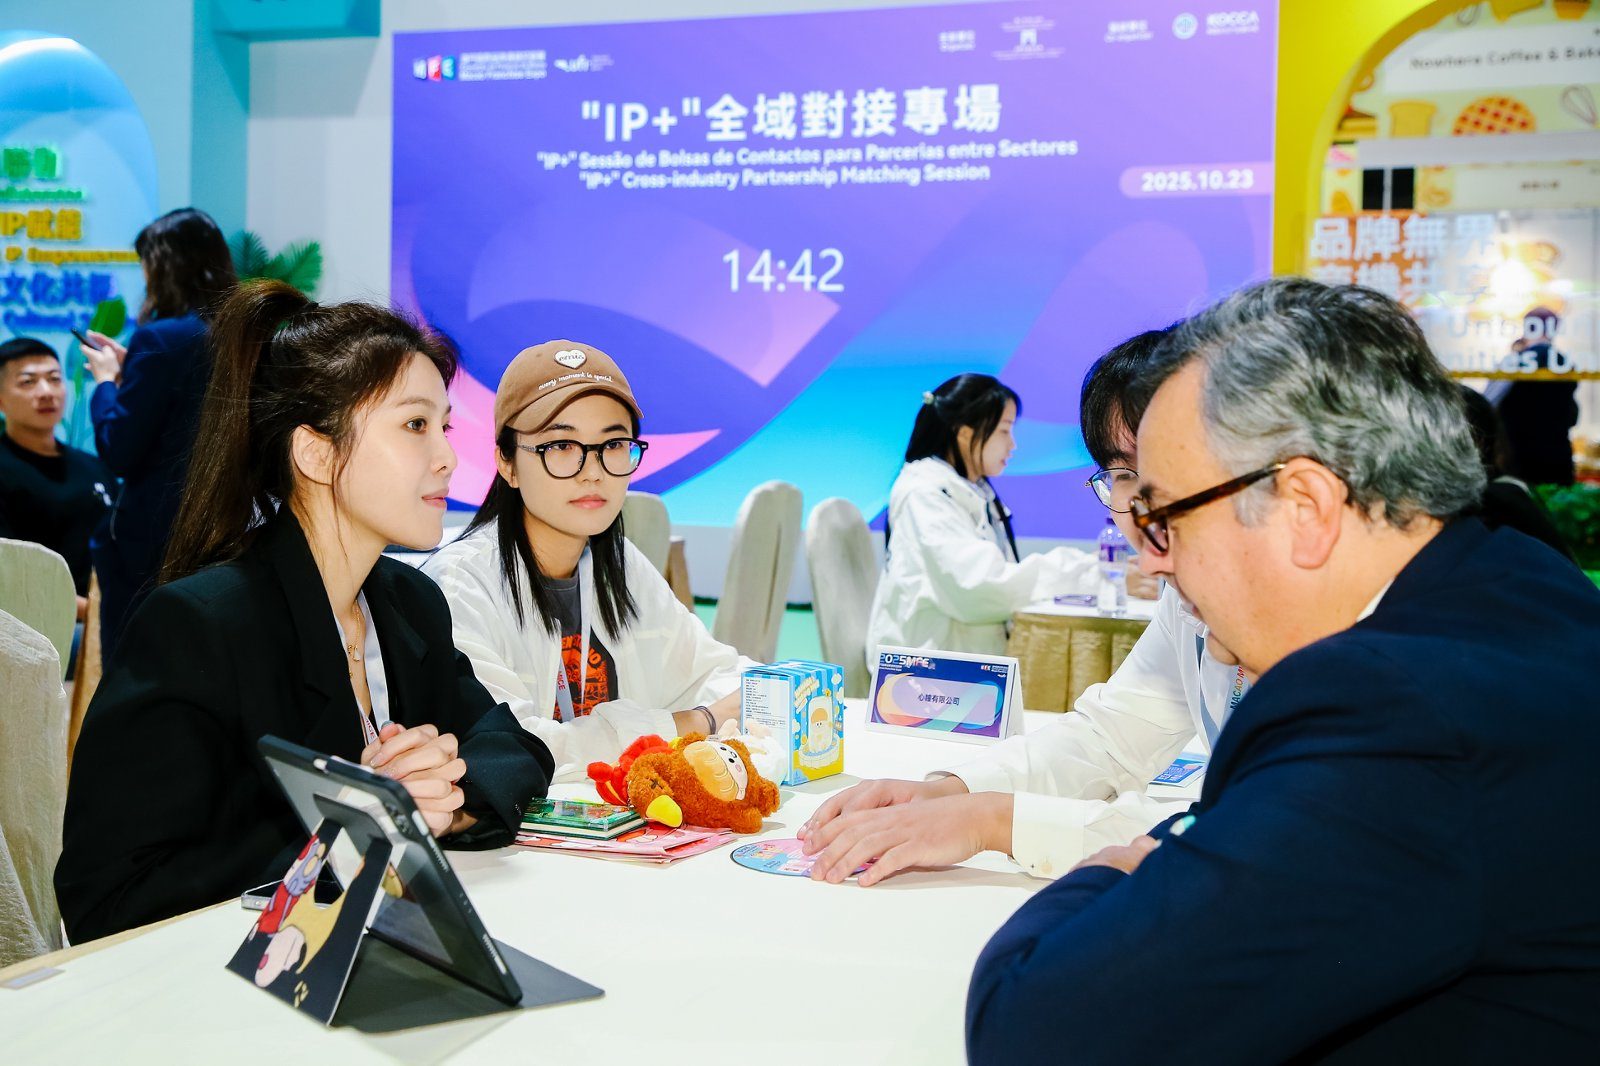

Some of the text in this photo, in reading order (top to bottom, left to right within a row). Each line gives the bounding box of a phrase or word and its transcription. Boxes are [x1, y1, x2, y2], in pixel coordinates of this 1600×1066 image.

[1411, 56, 1481, 70] Nowhere
[1487, 52, 1540, 65] Coffee
[579, 150, 633, 169] Sessão
[635, 150, 656, 168] de
[658, 149, 710, 167] Bolsas
[713, 148, 734, 166] de
[736, 146, 821, 165] Contactos
[824, 148, 862, 165] para
[866, 142, 944, 162] Parcerias
[947, 143, 995, 159] entre
[998, 139, 1078, 157] Sectores
[622, 168, 738, 190] Cross-industry
[742, 166, 838, 188] Partnership
[841, 165, 920, 186] Matching
[923, 162, 991, 181] Session
[1141, 170, 1254, 192] 2025.10.23
[723, 248, 845, 292] 14:42
